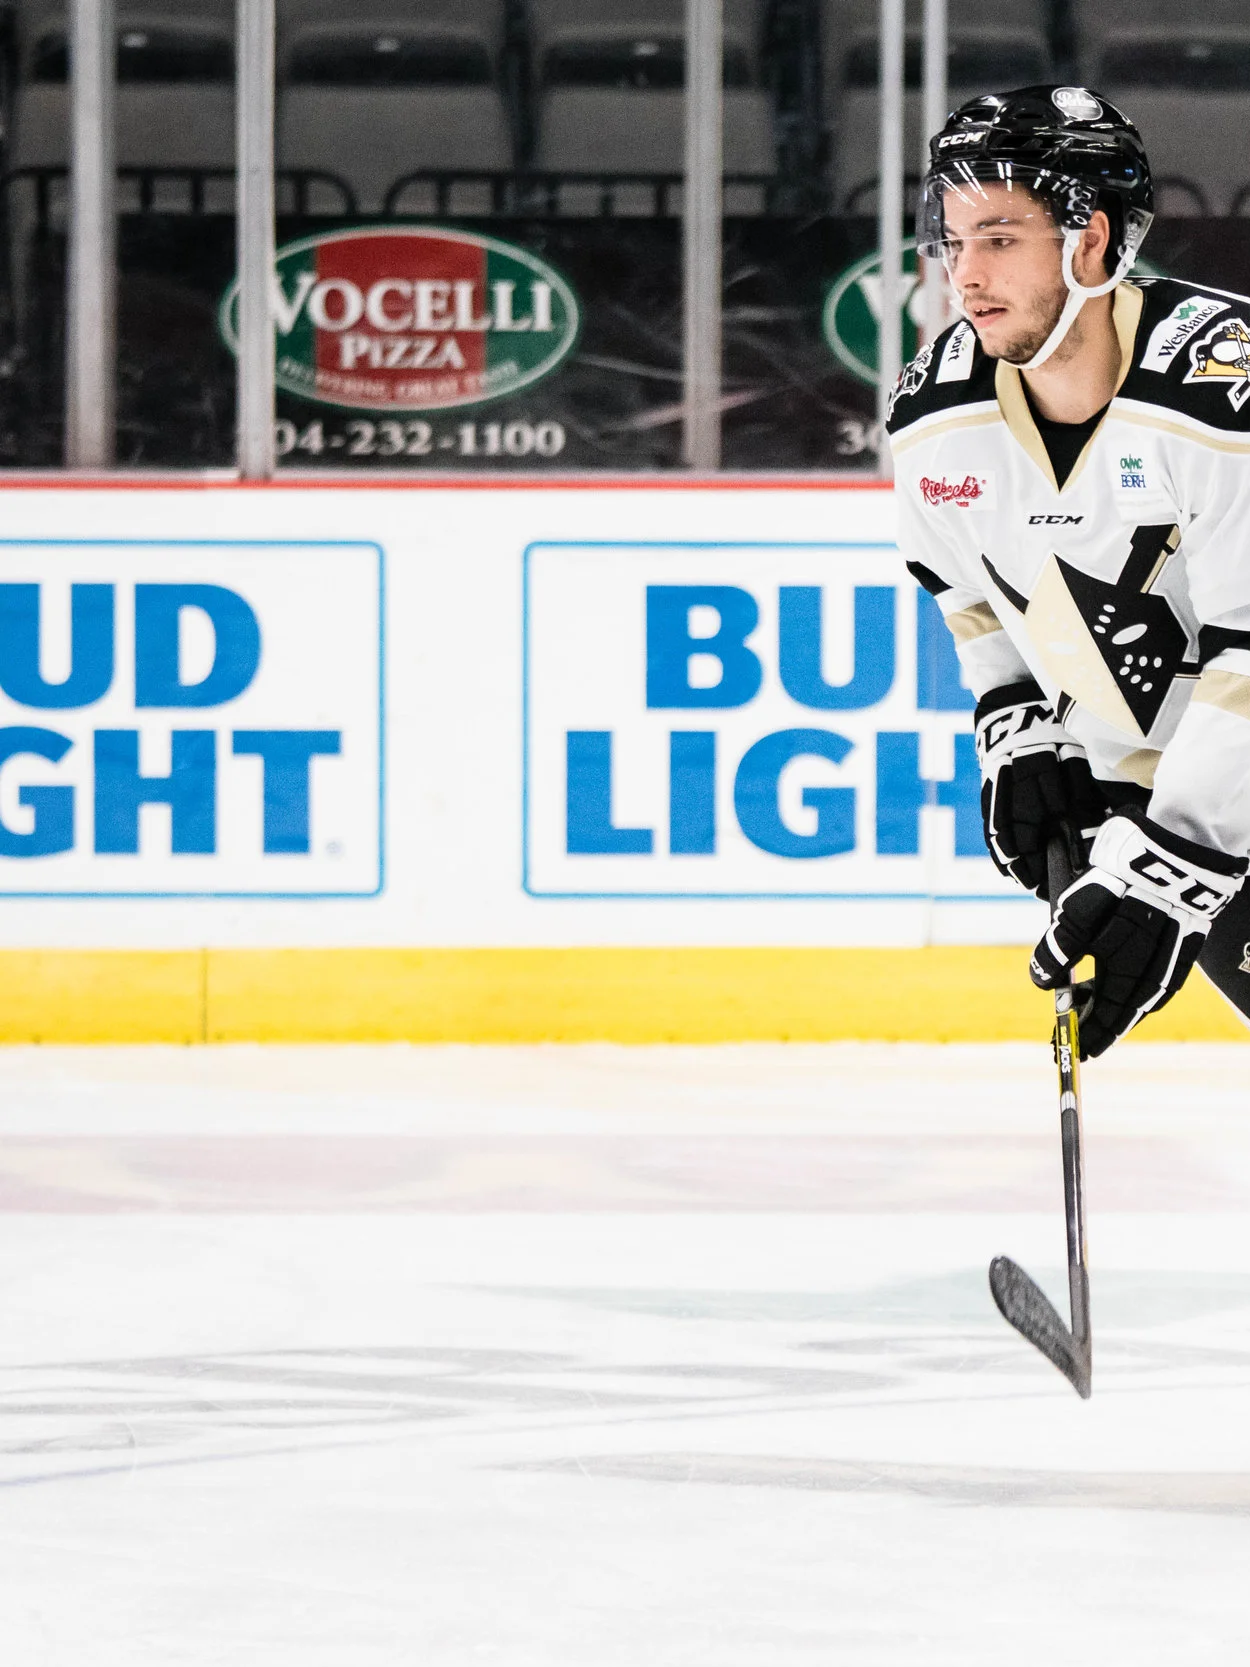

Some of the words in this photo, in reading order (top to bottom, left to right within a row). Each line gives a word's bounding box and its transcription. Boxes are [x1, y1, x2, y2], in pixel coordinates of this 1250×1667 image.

[939, 131, 986, 148] CCM
[268, 271, 556, 335] VOCELLI
[339, 334, 466, 370] PIZZA
[1158, 304, 1220, 358] WesBanco
[272, 420, 566, 457] 04-232-1100
[1028, 515, 1084, 525] CCM
[0, 583, 261, 710] UD
[978, 704, 1062, 753] CM
[0, 726, 342, 859] GHT
[565, 727, 991, 859] LIGH
[1129, 847, 1230, 915] CC
[1031, 956, 1051, 981] CM
